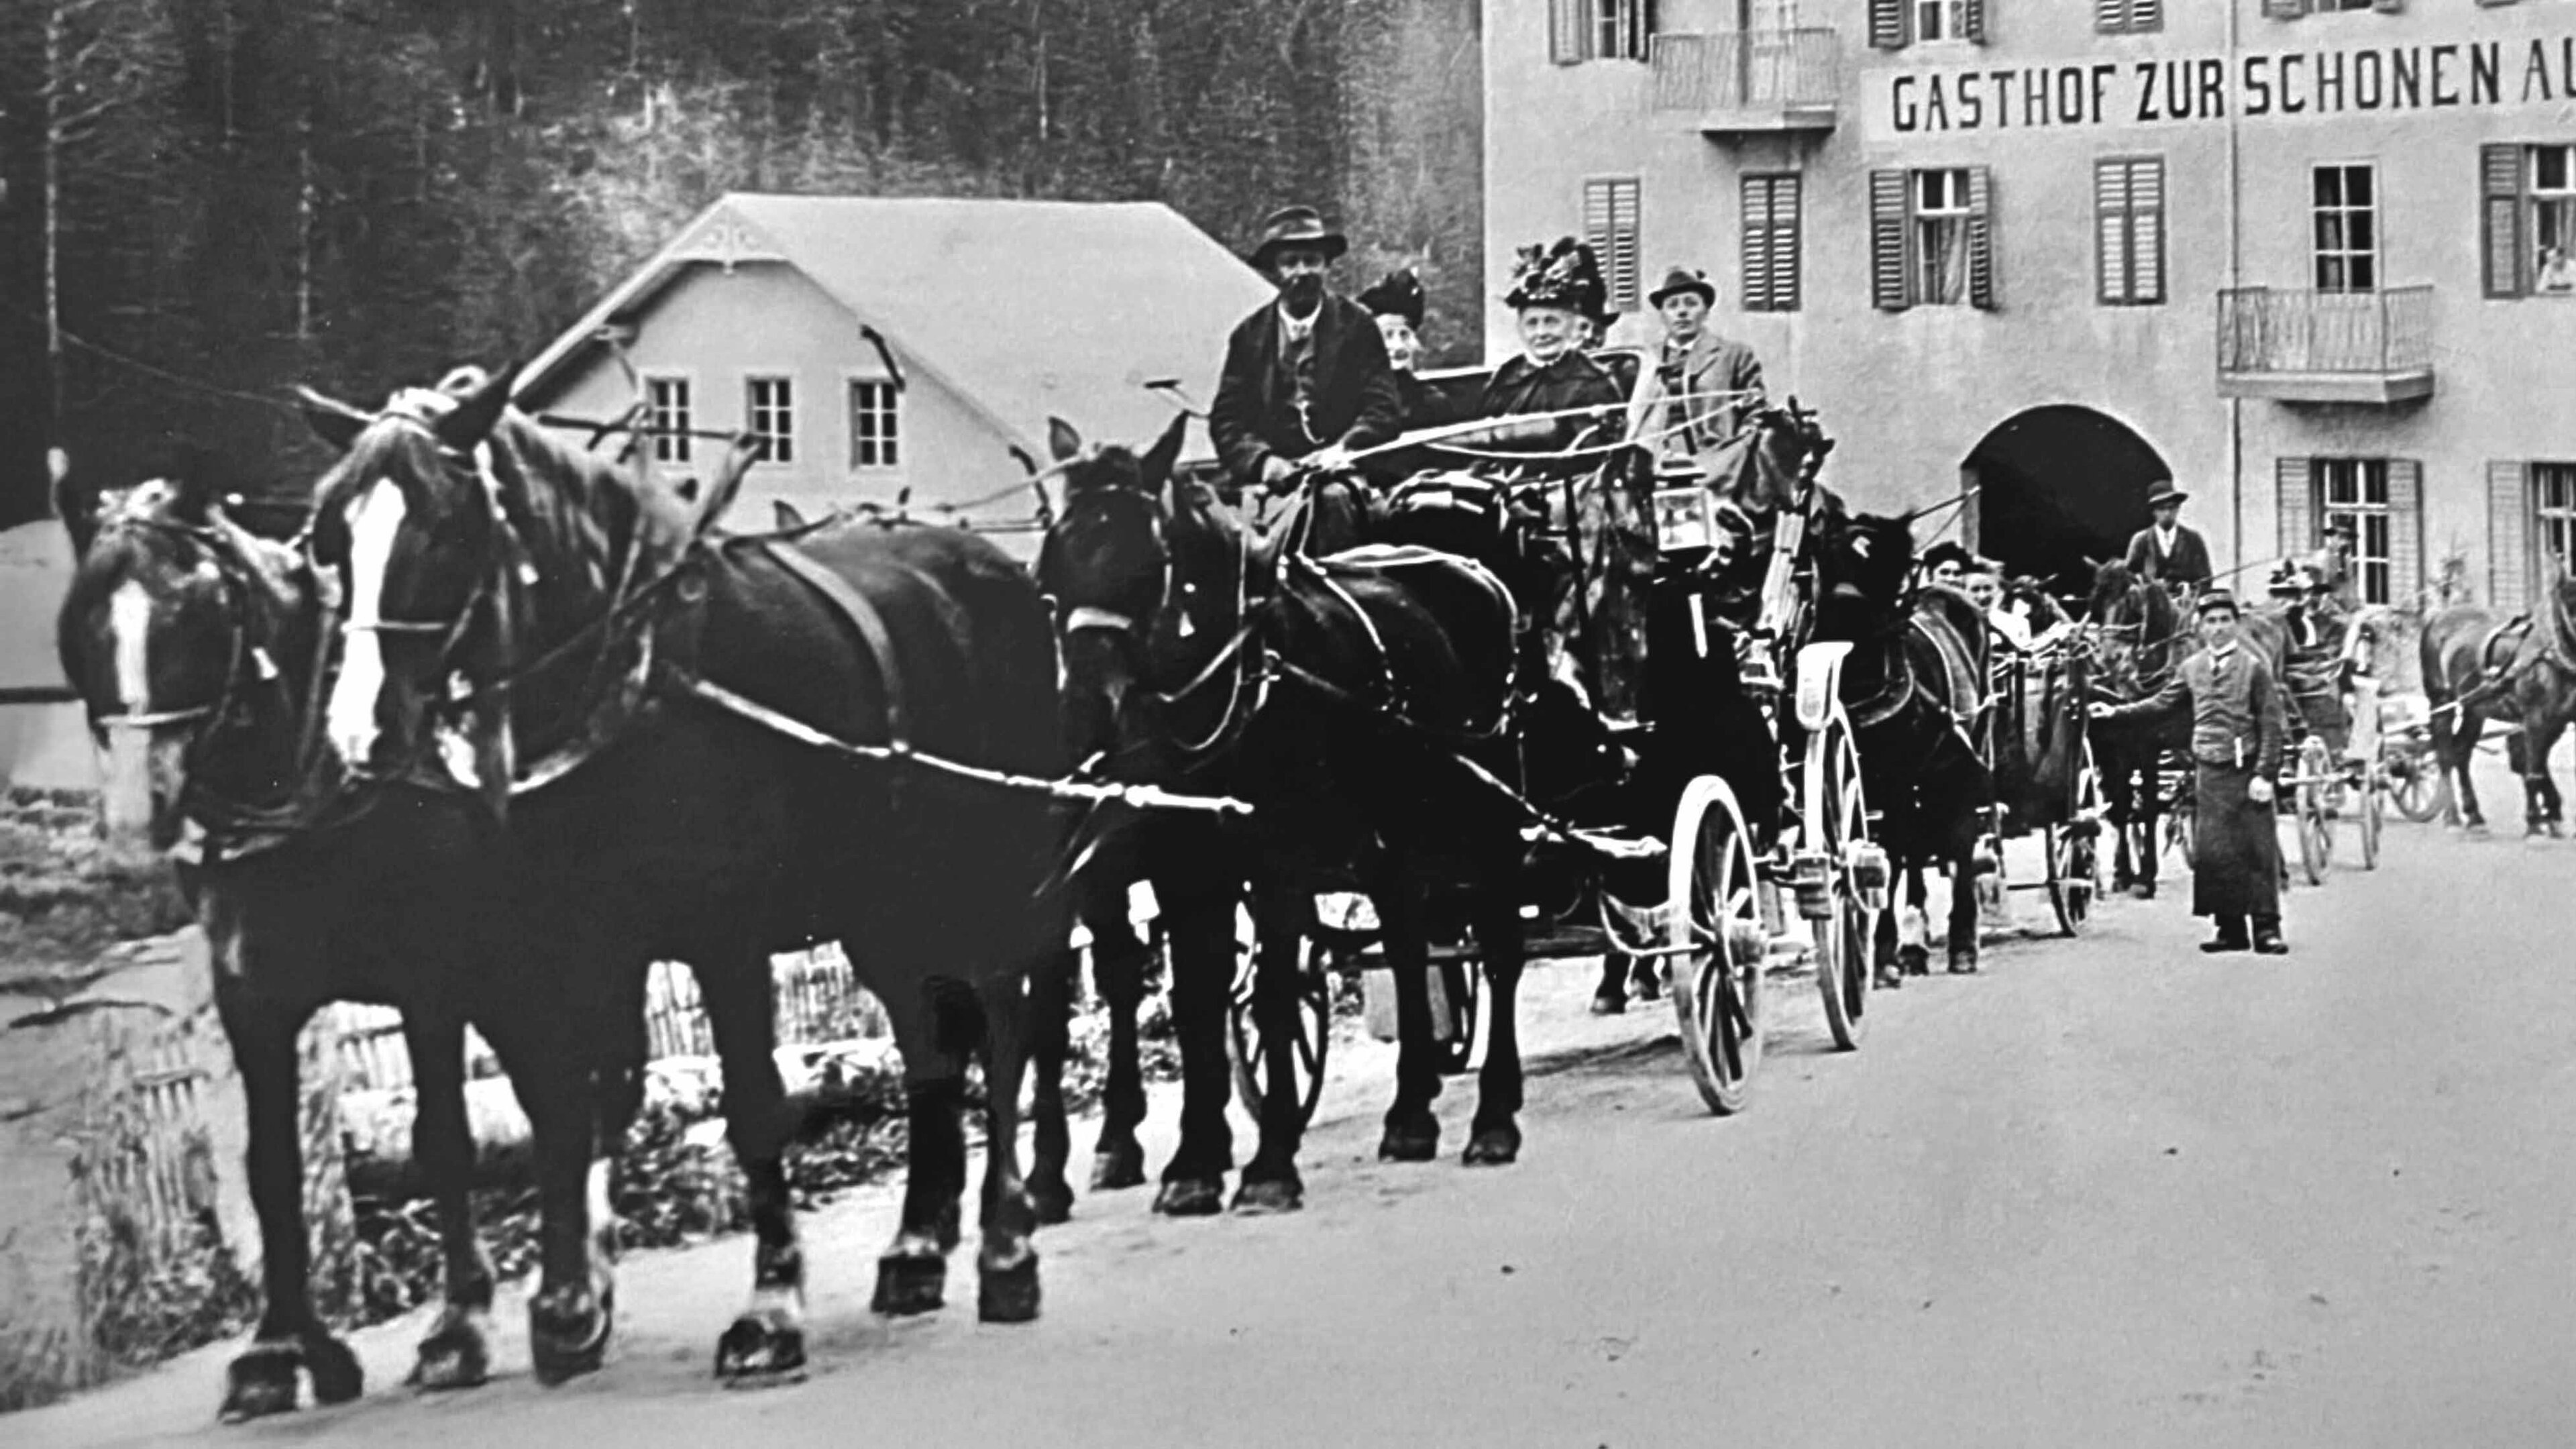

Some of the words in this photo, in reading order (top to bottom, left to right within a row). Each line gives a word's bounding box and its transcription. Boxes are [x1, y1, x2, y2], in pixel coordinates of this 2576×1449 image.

[1892, 64, 2116, 131] GASTHOF
[2136, 58, 2224, 121] ZUR
[2245, 42, 2500, 116] SCHONEN
